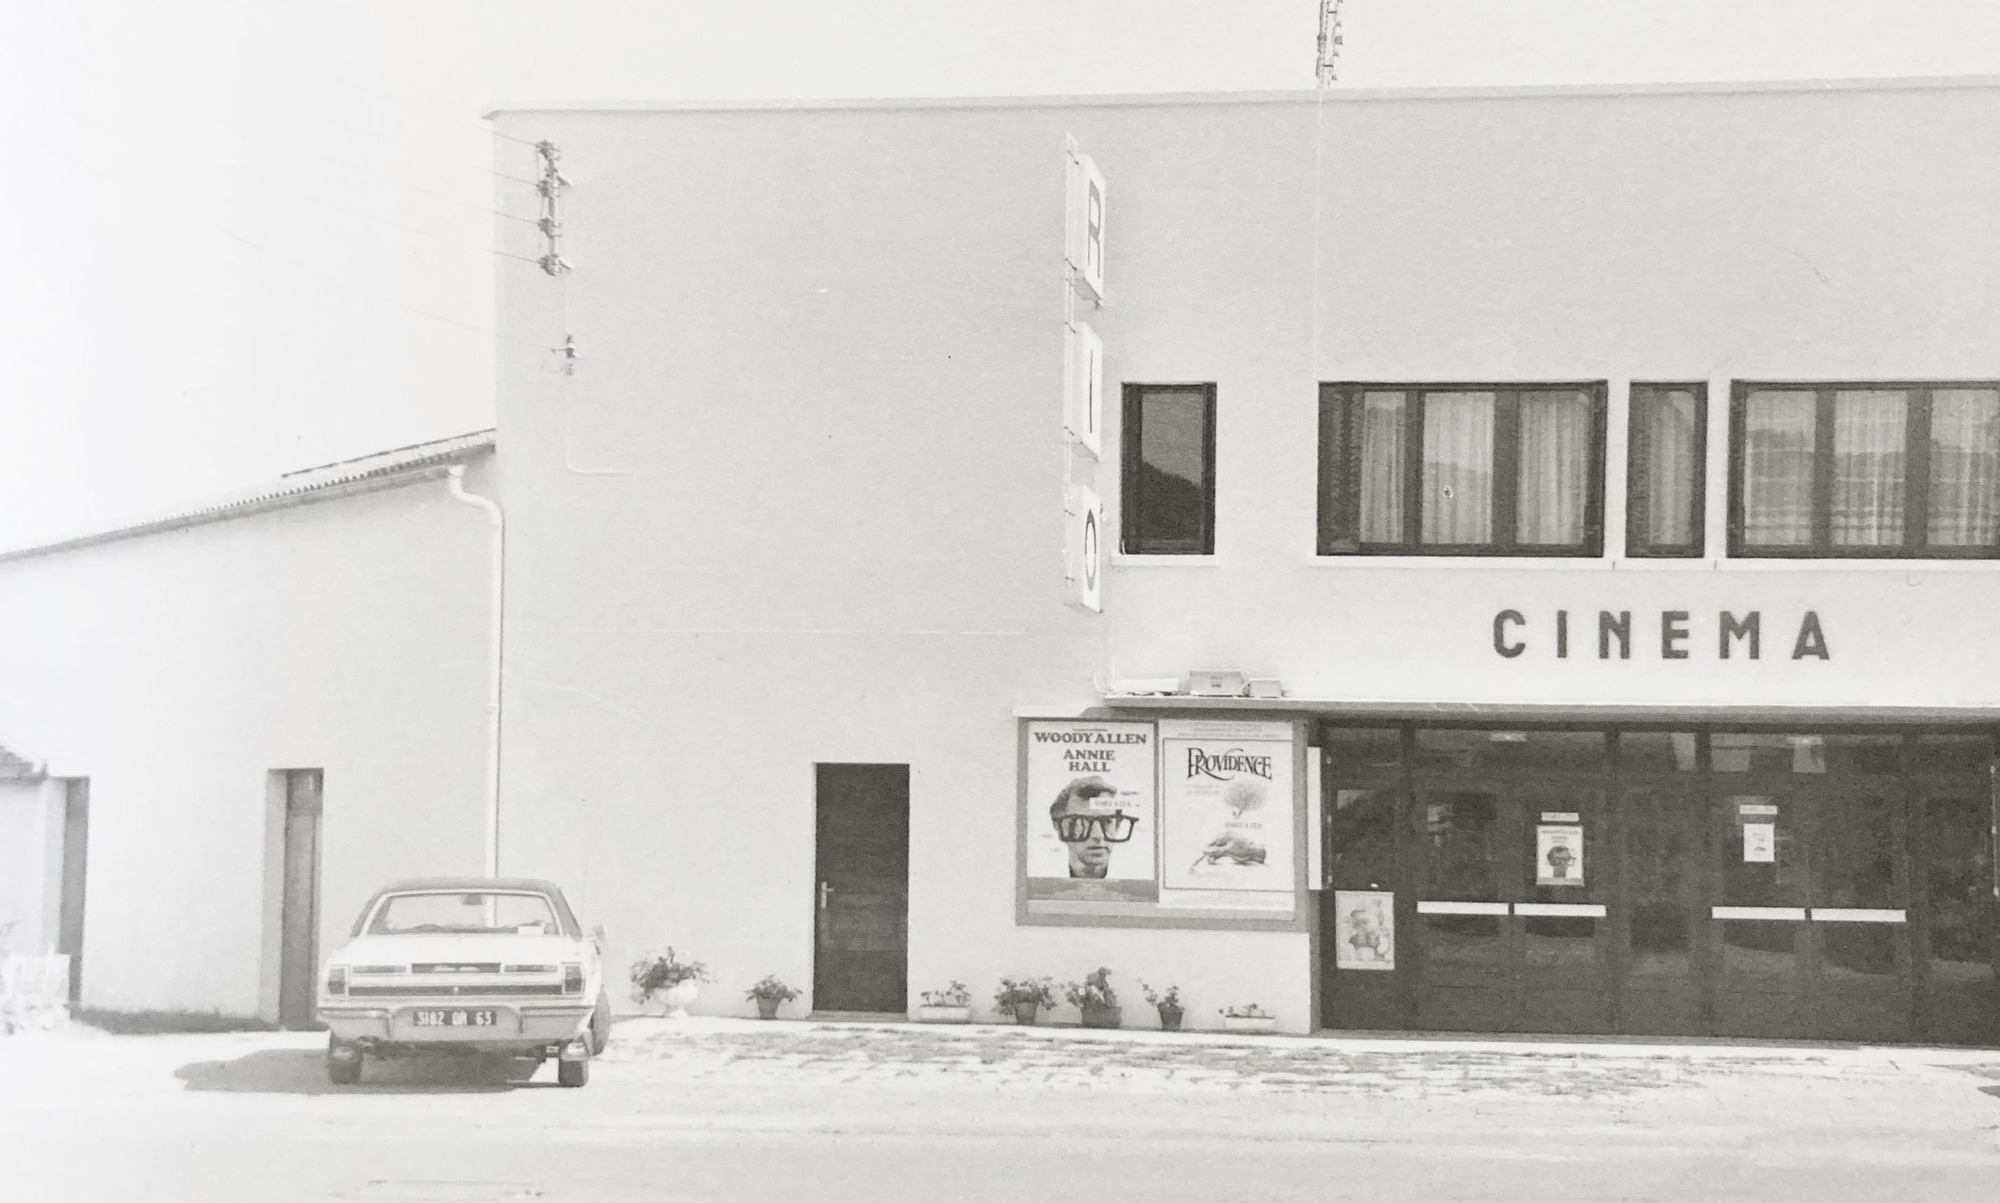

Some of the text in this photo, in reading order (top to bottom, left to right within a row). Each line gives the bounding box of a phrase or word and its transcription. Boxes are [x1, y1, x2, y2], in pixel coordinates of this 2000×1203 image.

[1493, 608, 1830, 661] CINEMA
[1034, 732, 1147, 745] WOODY ALLEN
[1063, 749, 1115, 761] ANNIE
[1069, 761, 1111, 772] HALL
[1187, 747, 1272, 781] PROVIDENCE
